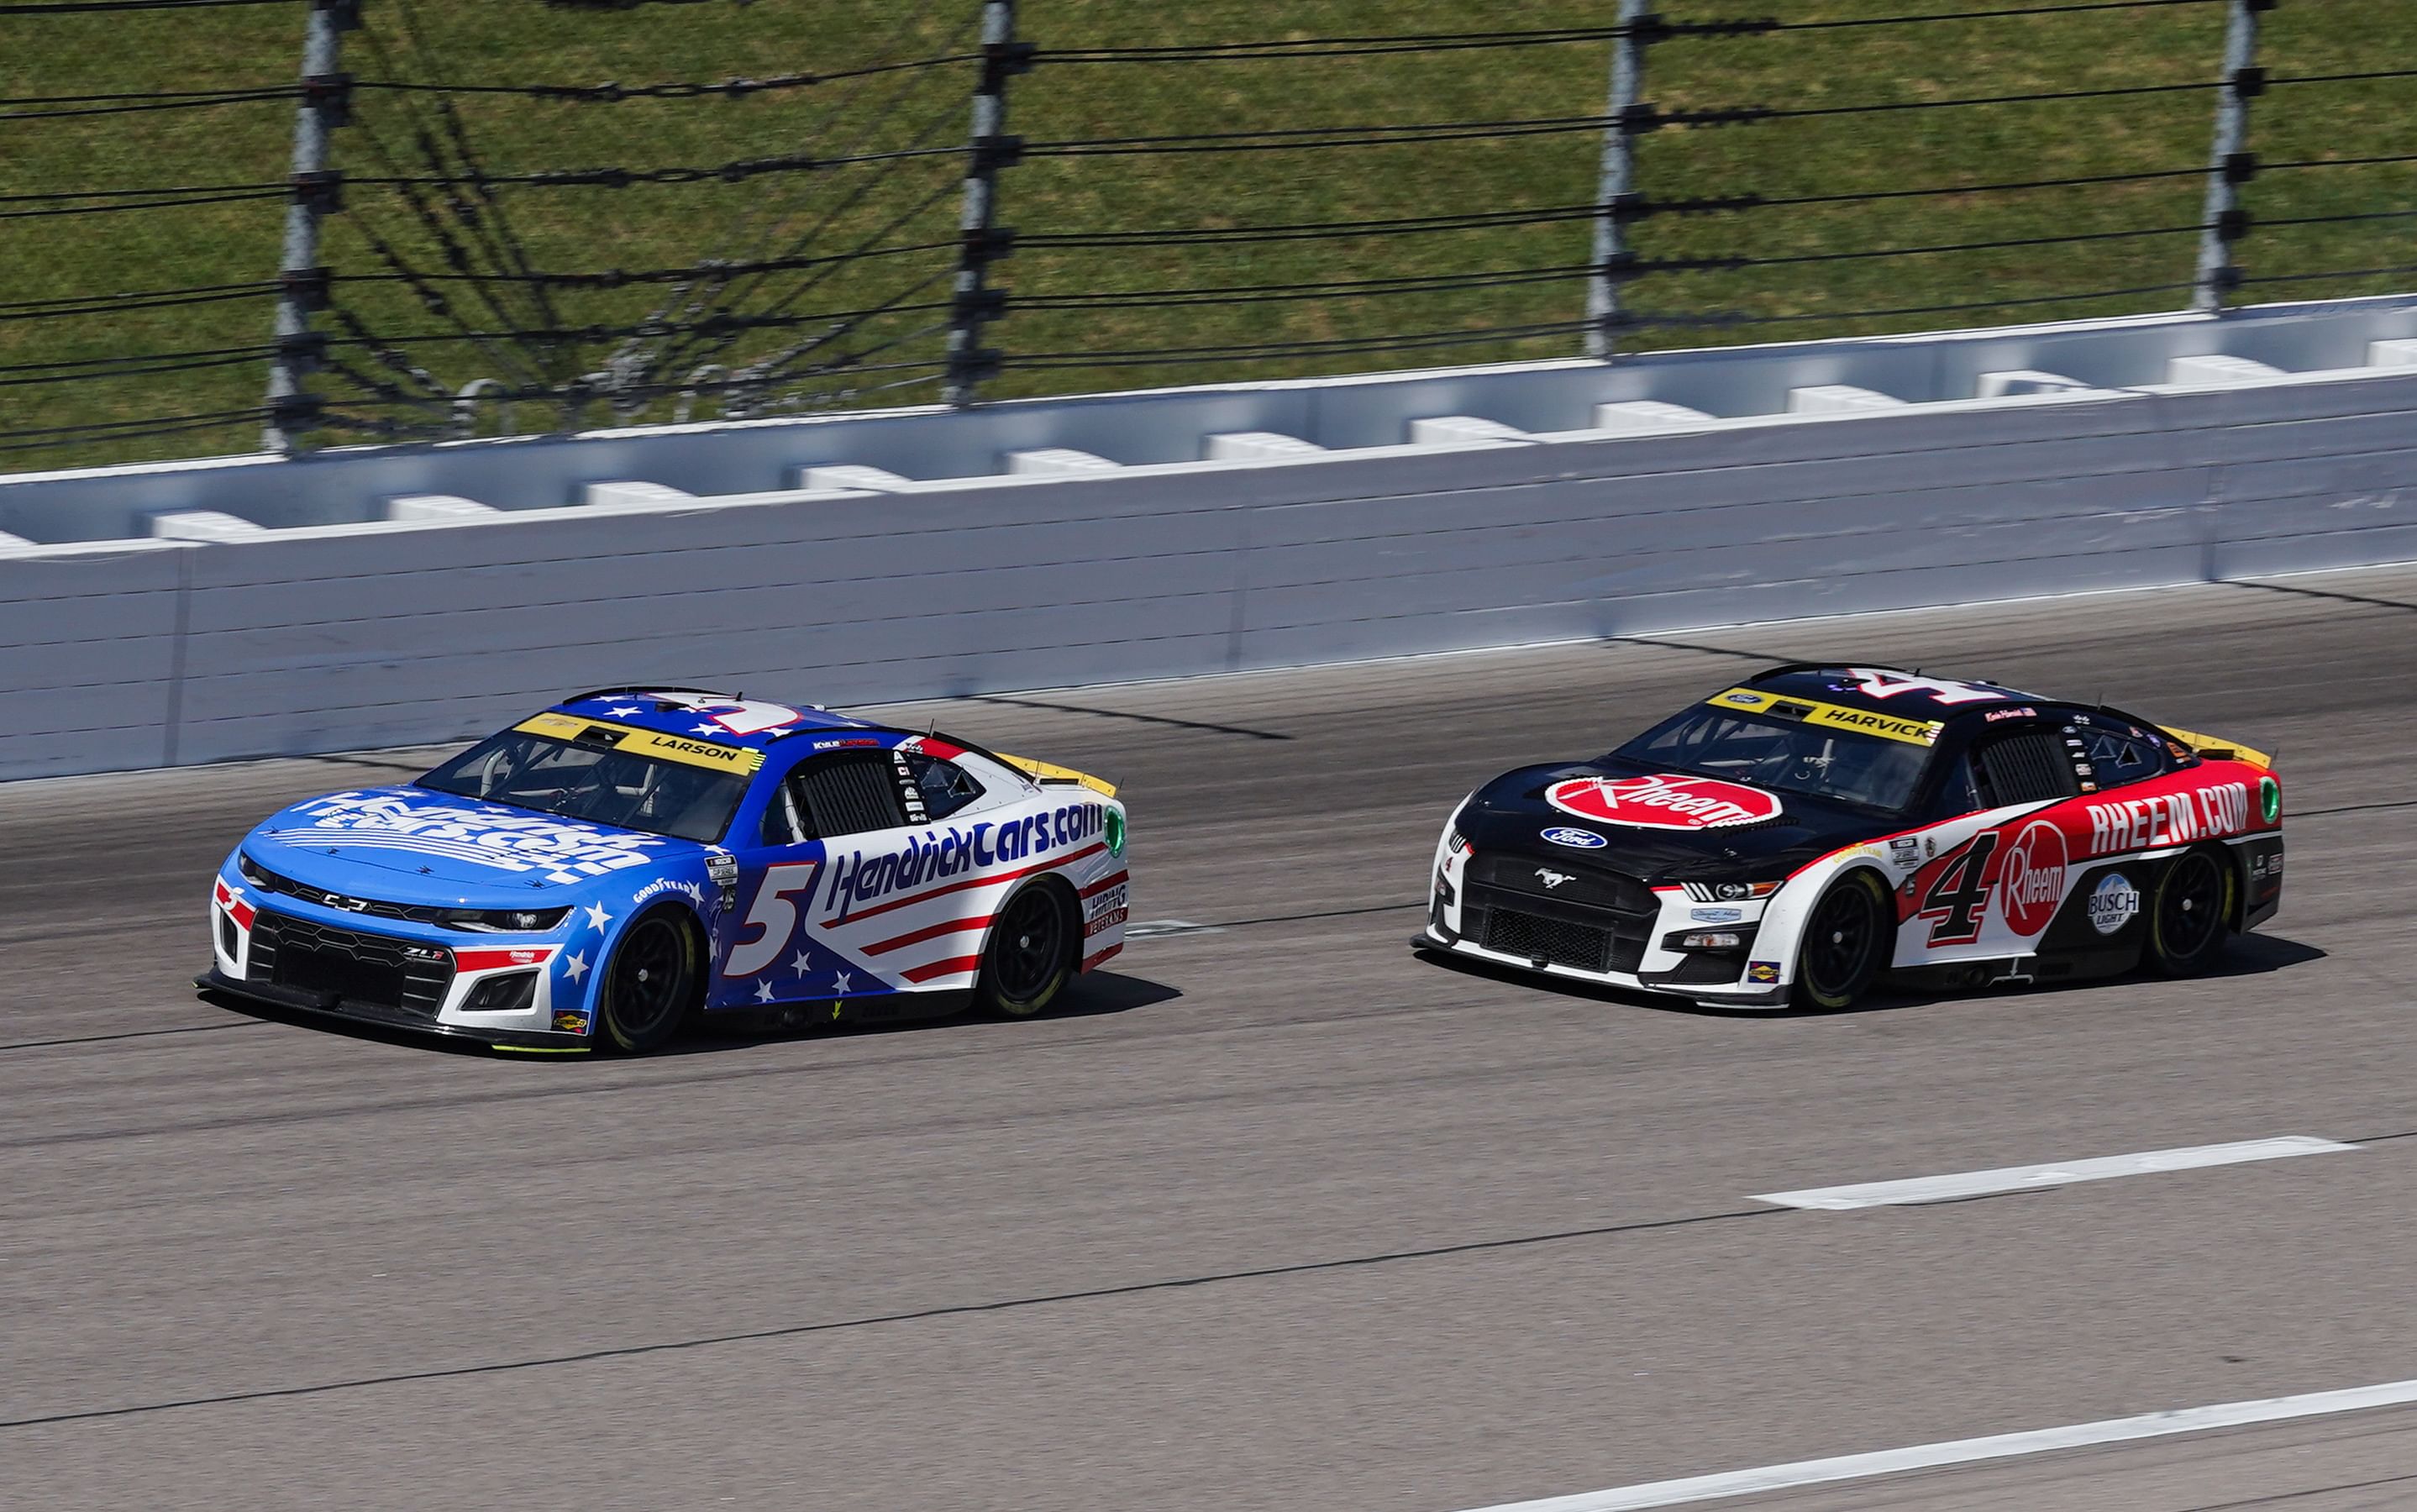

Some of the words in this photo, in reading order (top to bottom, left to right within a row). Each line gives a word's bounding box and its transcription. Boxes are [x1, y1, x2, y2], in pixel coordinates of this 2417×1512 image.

[1825, 710, 1931, 738] HARVICK
[650, 736, 738, 762] LARSON
[1557, 775, 1758, 826] Rheem
[2086, 781, 2249, 854] RHEEM.COM
[1551, 827, 1595, 846] Ford
[826, 802, 1103, 924] HendrickCars.com
[633, 877, 691, 904] GOODYEAR
[1919, 827, 2000, 948] 4
[2005, 845, 2064, 921] Rheem
[722, 861, 818, 978] 5
[2089, 892, 2137, 915] BUSCH
[2097, 913, 2123, 925] LIGHT
